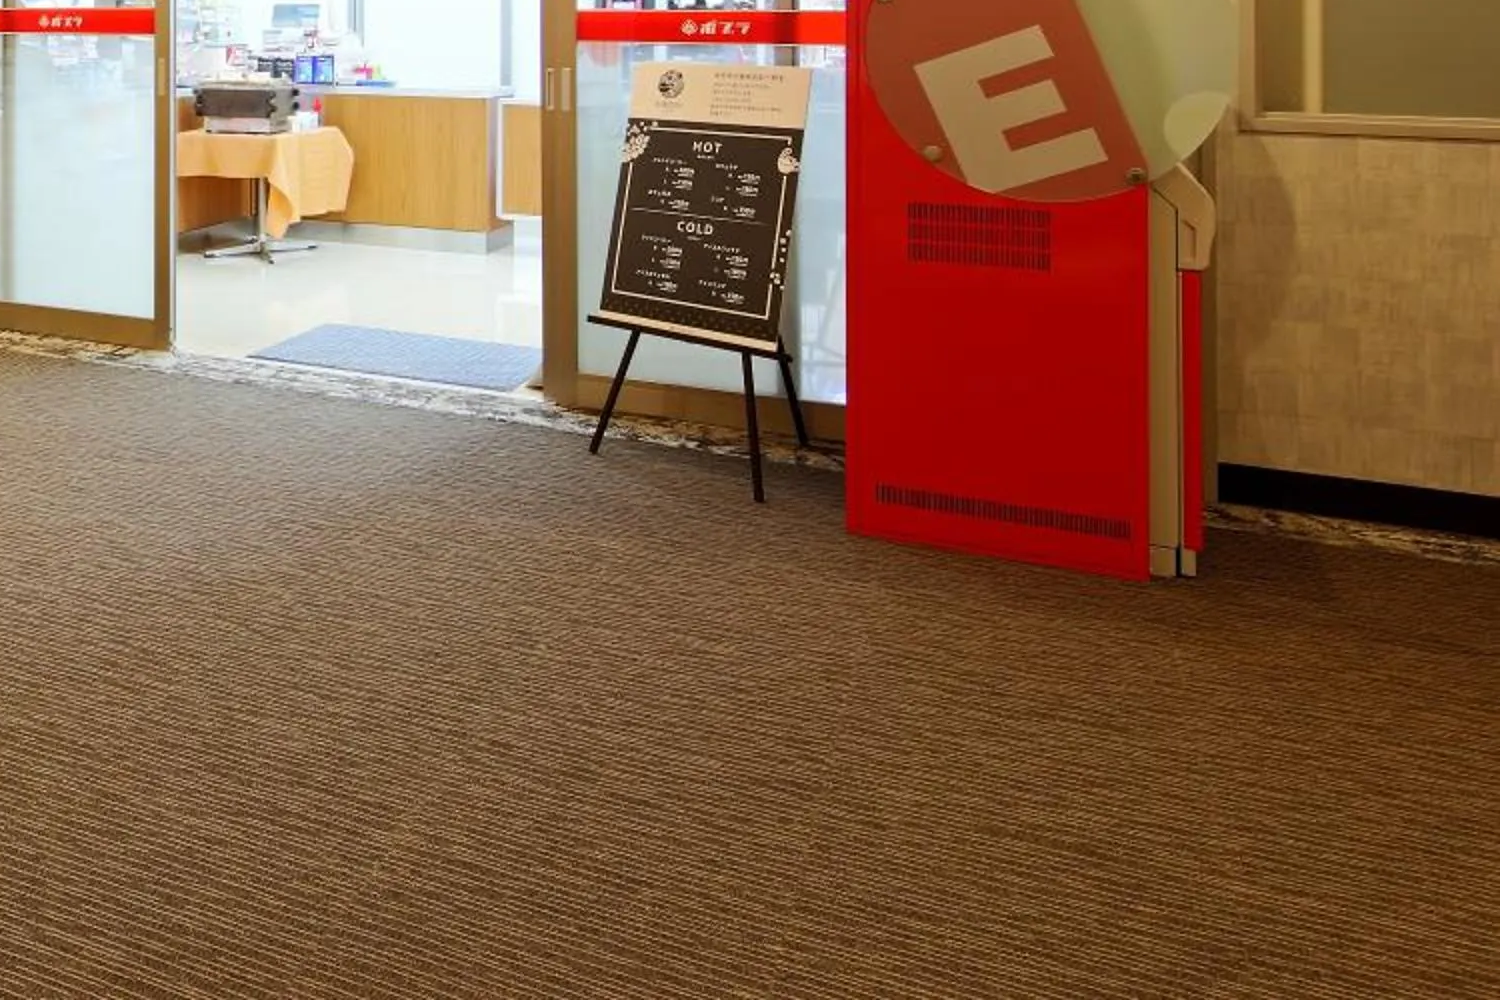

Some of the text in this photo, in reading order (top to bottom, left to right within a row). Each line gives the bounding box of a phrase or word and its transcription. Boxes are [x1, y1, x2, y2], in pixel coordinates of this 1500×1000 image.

[700, 19, 751, 35] ポプラ
[692, 141, 723, 153] HOT
[677, 221, 714, 235] COLD
